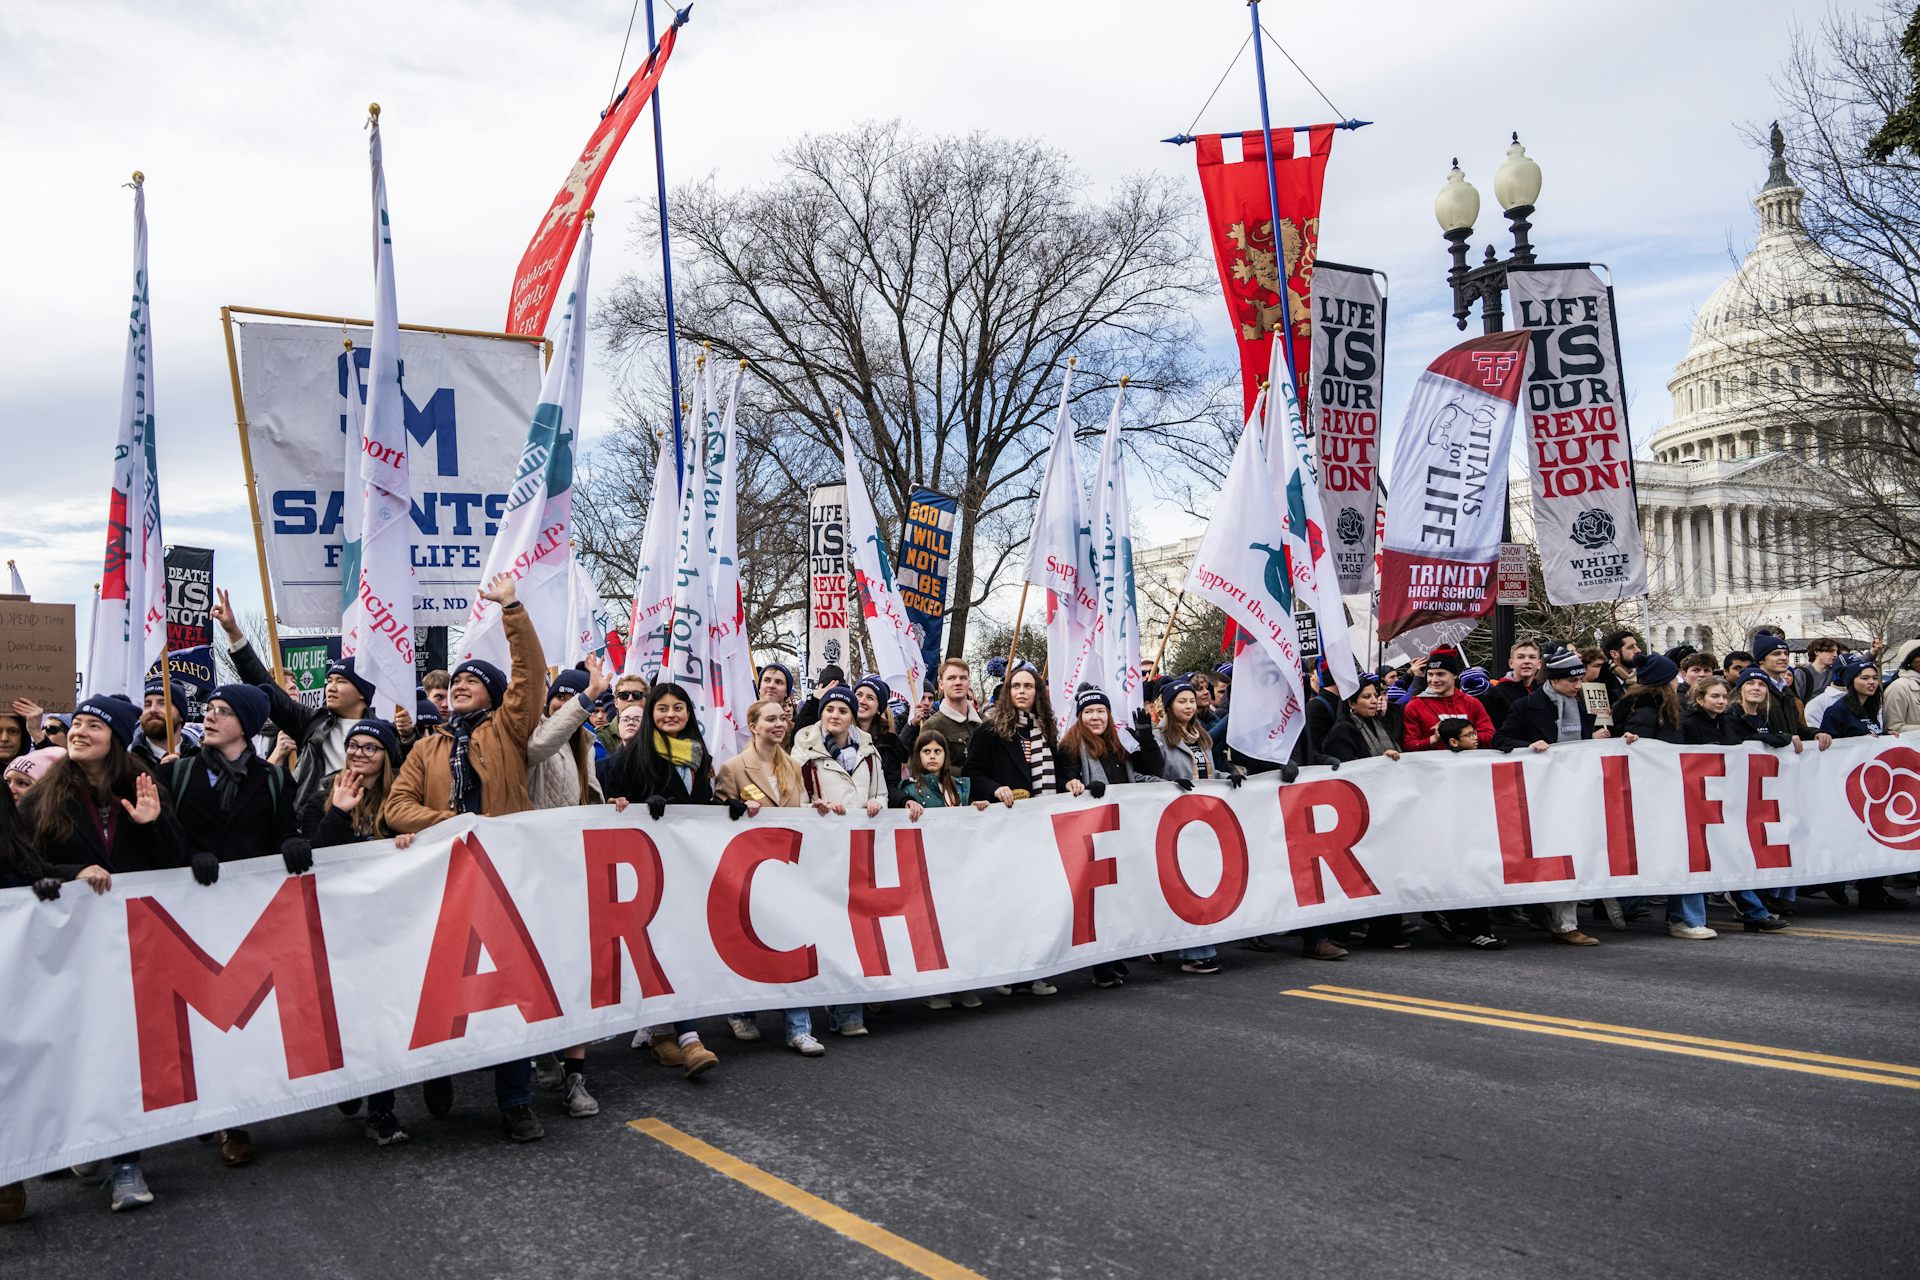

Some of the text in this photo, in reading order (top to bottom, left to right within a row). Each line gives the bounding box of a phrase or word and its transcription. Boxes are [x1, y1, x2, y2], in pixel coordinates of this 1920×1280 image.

[1319, 296, 1375, 329] LIFE
[1519, 296, 1599, 328] LIFE
[1320, 326, 1376, 381] IS
[1528, 323, 1605, 382] IS
[1320, 378, 1376, 409] OUR
[1529, 378, 1614, 411] OUR
[1321, 407, 1376, 436] REVO
[1533, 405, 1617, 438] REVO
[1321, 433, 1375, 465] LUT
[1449, 442, 1467, 467] for
[1535, 433, 1620, 468] LUT
[1462, 428, 1492, 518] TITANS
[1538, 460, 1631, 499] ION!
[272, 490, 510, 536] SANTS
[812, 504, 843, 523] LIFE
[909, 501, 940, 527] GOD
[1421, 465, 1461, 548] LIFE
[812, 523, 845, 557] IS
[913, 525, 949, 556] WILL
[1501, 546, 1520, 556] SNOW
[410, 545, 480, 567] LIFE
[905, 547, 937, 574] NOT
[1337, 552, 1366, 563] WHIT
[1570, 553, 1630, 569] WHITE
[168, 566, 211, 583] DEATH
[1409, 565, 1491, 587] TRINITY
[1501, 564, 1524, 572] ROUTE
[1507, 573, 1527, 581] PARKING
[1581, 565, 1624, 580] ROSE
[813, 575, 846, 592] REVO
[918, 573, 941, 598] BE
[1408, 584, 1488, 600] HIGH SCHOOL
[1504, 582, 1522, 590] DURING
[1577, 576, 1631, 587] RESISTANCE
[168, 579, 210, 612] IS
[444, 598, 468, 610] ND
[1196, 564, 1248, 604] Support
[1247, 600, 1268, 625] the
[1500, 590, 1527, 598] EMERGENCY
[166, 607, 208, 627] NOT
[1413, 601, 1481, 613] DICKINSON, ND
[44, 615, 65, 625] TIME
[1296, 619, 1312, 629] HE
[167, 623, 208, 644] WEL
[6, 662, 32, 672] HATE
[287, 649, 326, 671] LOVE LIFE
[474, 667, 491, 684] FOR LIFE
[299, 691, 321, 709] OOSE
[1586, 689, 1607, 700] LIFE
[1589, 700, 1597, 708] IS
[90, 706, 113, 722] FOR LIFE
[126, 752, 1791, 1113] MARCH FOR LIFE
